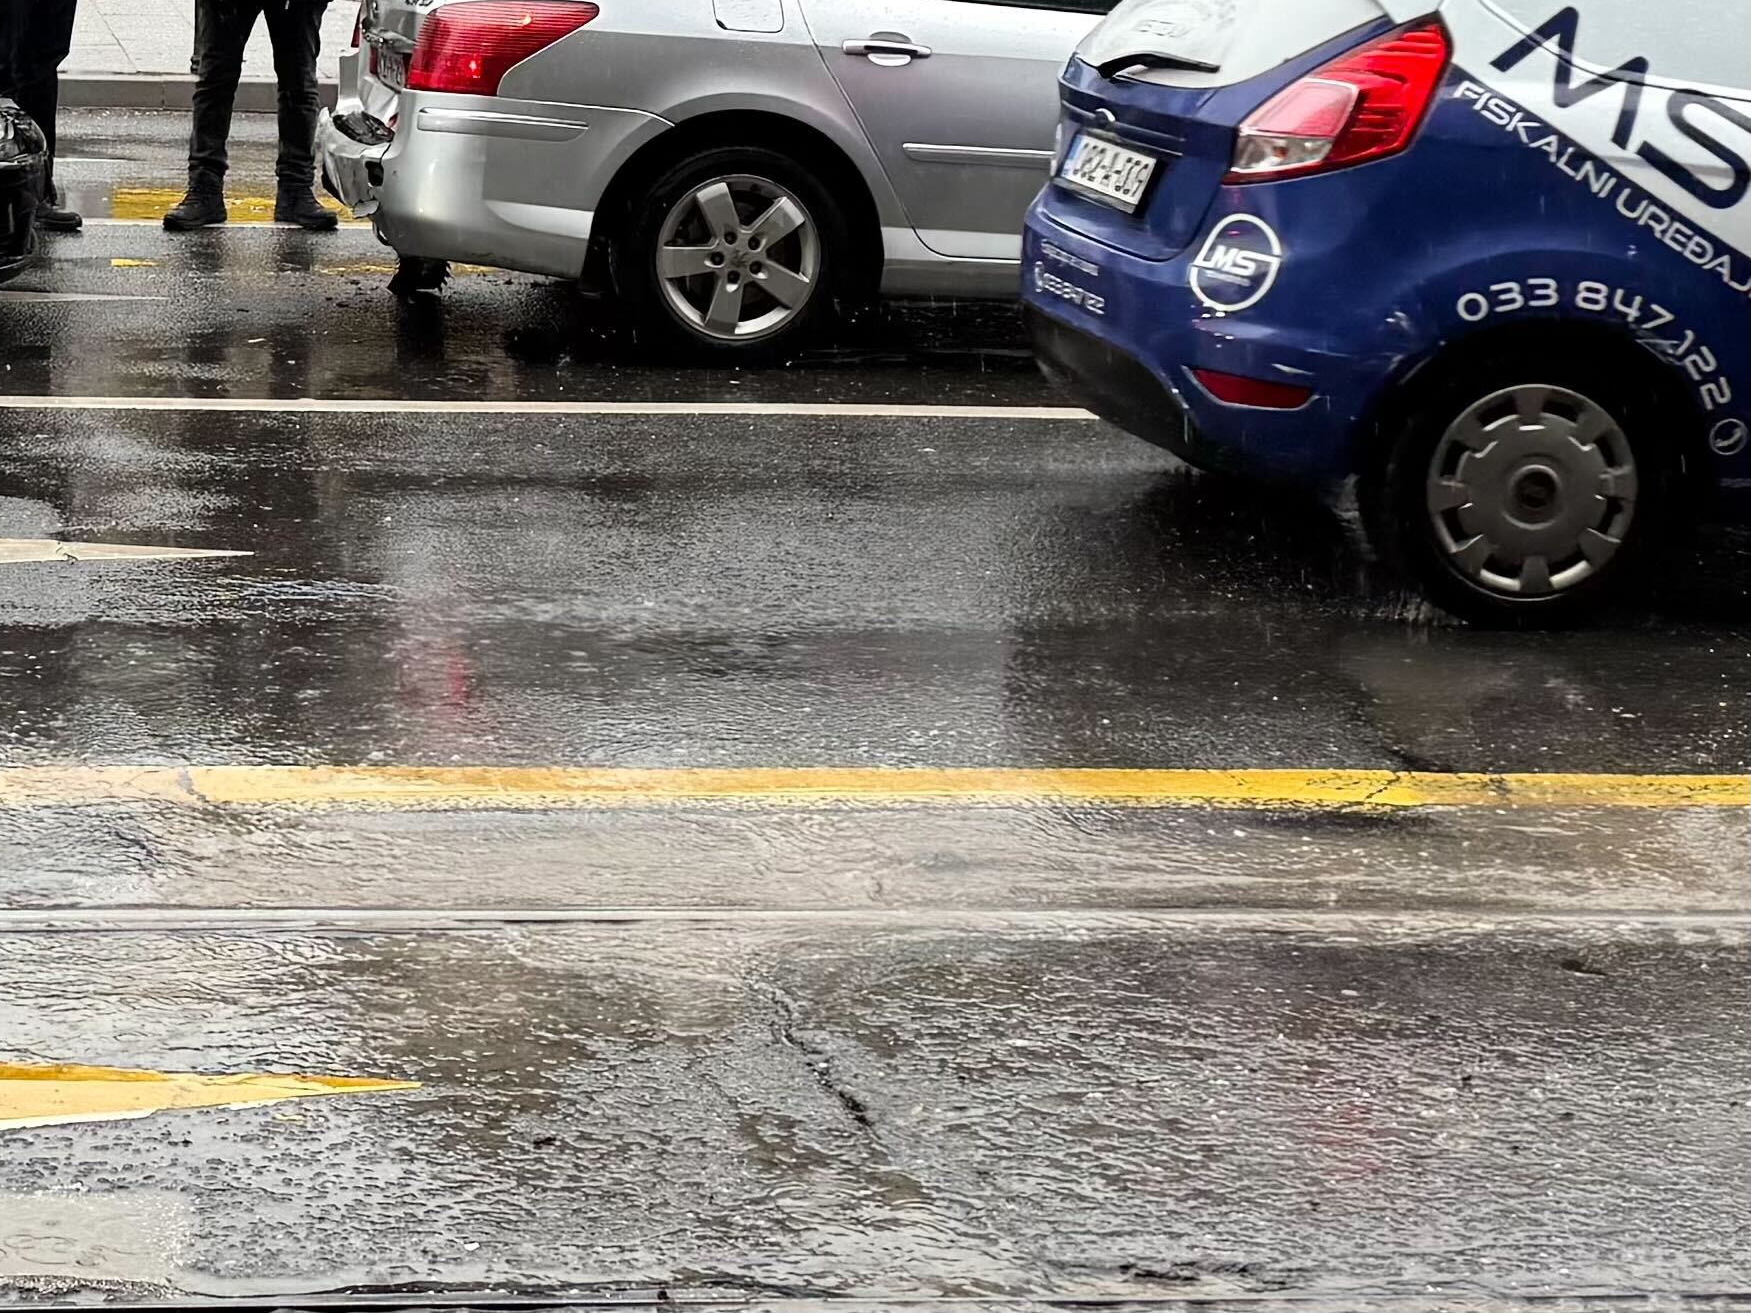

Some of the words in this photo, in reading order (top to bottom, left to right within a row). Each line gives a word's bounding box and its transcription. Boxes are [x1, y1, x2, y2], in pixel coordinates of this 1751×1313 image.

[1453, 80, 1612, 198] FISKALNI
[1615, 188, 1751, 298] UREĐAJ
[1490, 6, 1751, 211] MS
[1211, 244, 1257, 276] MS
[1456, 278, 1559, 322] 033
[1573, 281, 1676, 329] 847
[1674, 329, 1733, 411] 122
